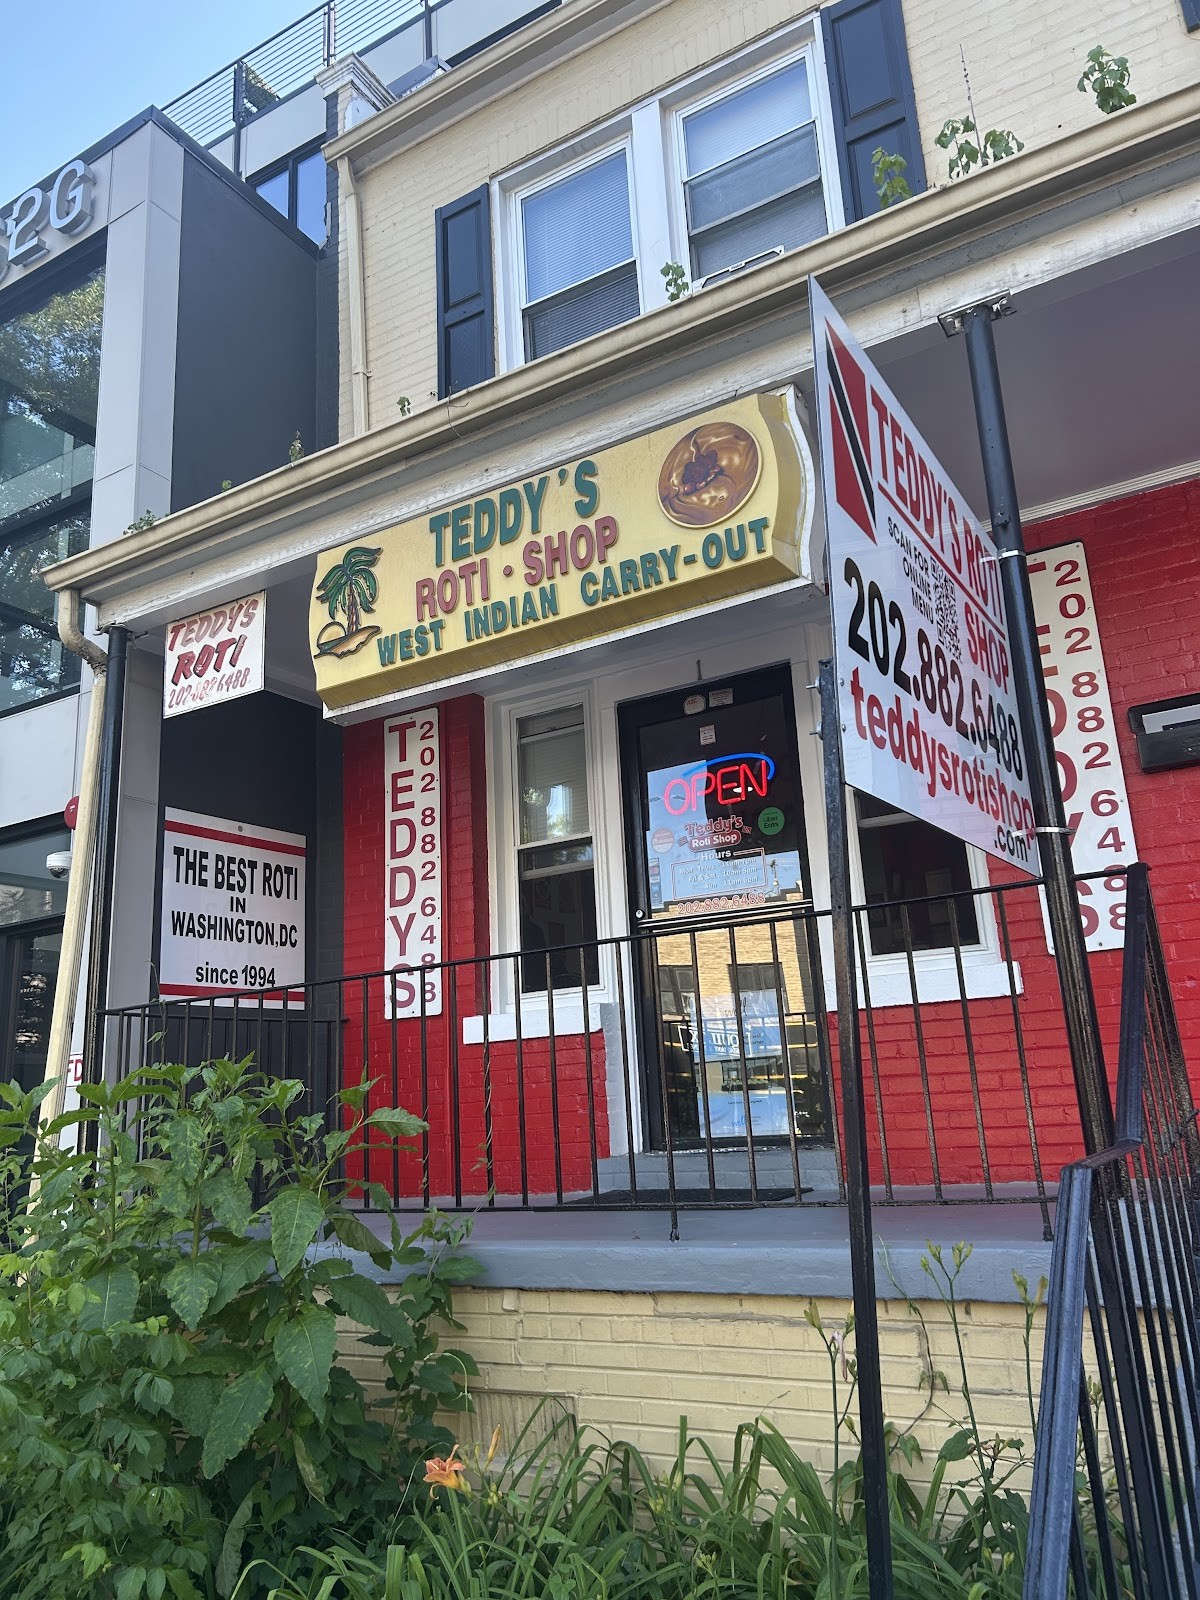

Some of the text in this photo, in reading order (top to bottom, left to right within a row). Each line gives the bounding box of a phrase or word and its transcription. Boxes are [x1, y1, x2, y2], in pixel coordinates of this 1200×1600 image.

[0, 159, 96, 268] 2G
[429, 460, 600, 567] TEDDY'S
[870, 384, 1004, 626] TEDDY'S ROTI
[416, 516, 618, 622] ROTI SHOP
[888, 516, 929, 578] SCAN FOR
[377, 517, 769, 667] WEST INDIAN CARRY-OUT
[903, 557, 932, 601] ONLINE
[168, 598, 259, 651] TEDDY'S
[911, 587, 934, 625] MENU
[171, 633, 248, 686] ROTI
[844, 557, 1023, 782] 202.882.6488
[964, 602, 1009, 695] SHOP
[851, 667, 1035, 850] teddysrotishop
[664, 759, 768, 815] OPEN
[684, 815, 744, 837] Teddy's
[692, 833, 738, 848] Roti Shop
[994, 824, 1029, 863] .com
[173, 846, 298, 900] THE BEST ROTI
[388, 720, 417, 1010] TEDDYS
[701, 850, 732, 861] Hours
[171, 910, 298, 948] WASHINGTON,DC
[230, 896, 246, 913] IN
[677, 892, 766, 915] 202.882.6488
[195, 962, 276, 988] since 1994
